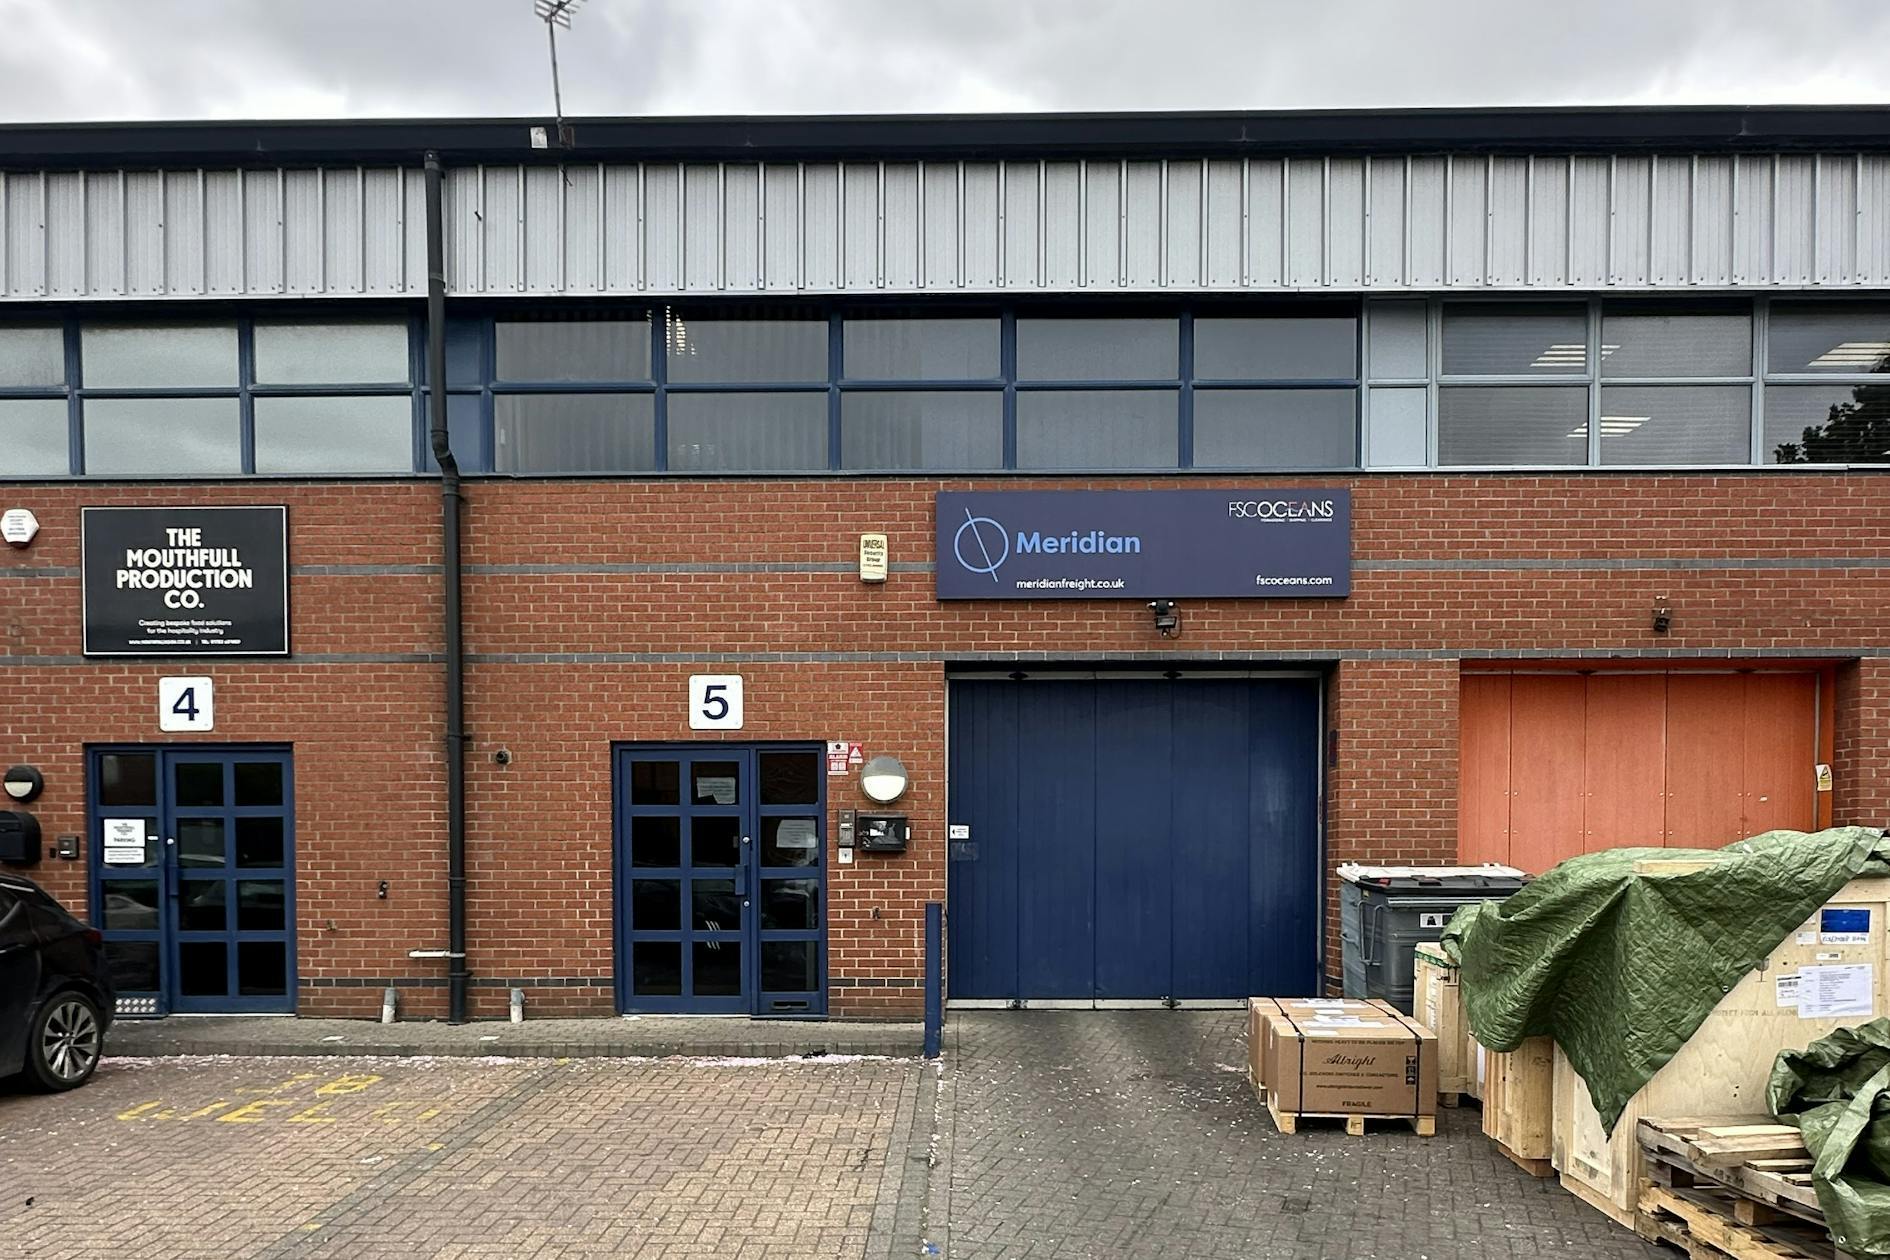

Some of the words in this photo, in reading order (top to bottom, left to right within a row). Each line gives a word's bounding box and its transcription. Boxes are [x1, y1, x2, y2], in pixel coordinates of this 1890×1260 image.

[1228, 500, 1334, 518] FSCOCEANS
[166, 528, 201, 547] THE
[1016, 530, 1141, 555] Meridian
[126, 548, 242, 568] MOUTHFULL
[116, 569, 253, 589] PRODUCTION
[1016, 577, 1125, 591] meridianfreight.co.uk
[1256, 574, 1333, 585] fscoceans.com
[164, 589, 205, 609] CO.
[138, 619, 165, 627] Creating
[165, 619, 190, 627] bespoke
[172, 687, 200, 722] 4
[701, 684, 729, 720] 5
